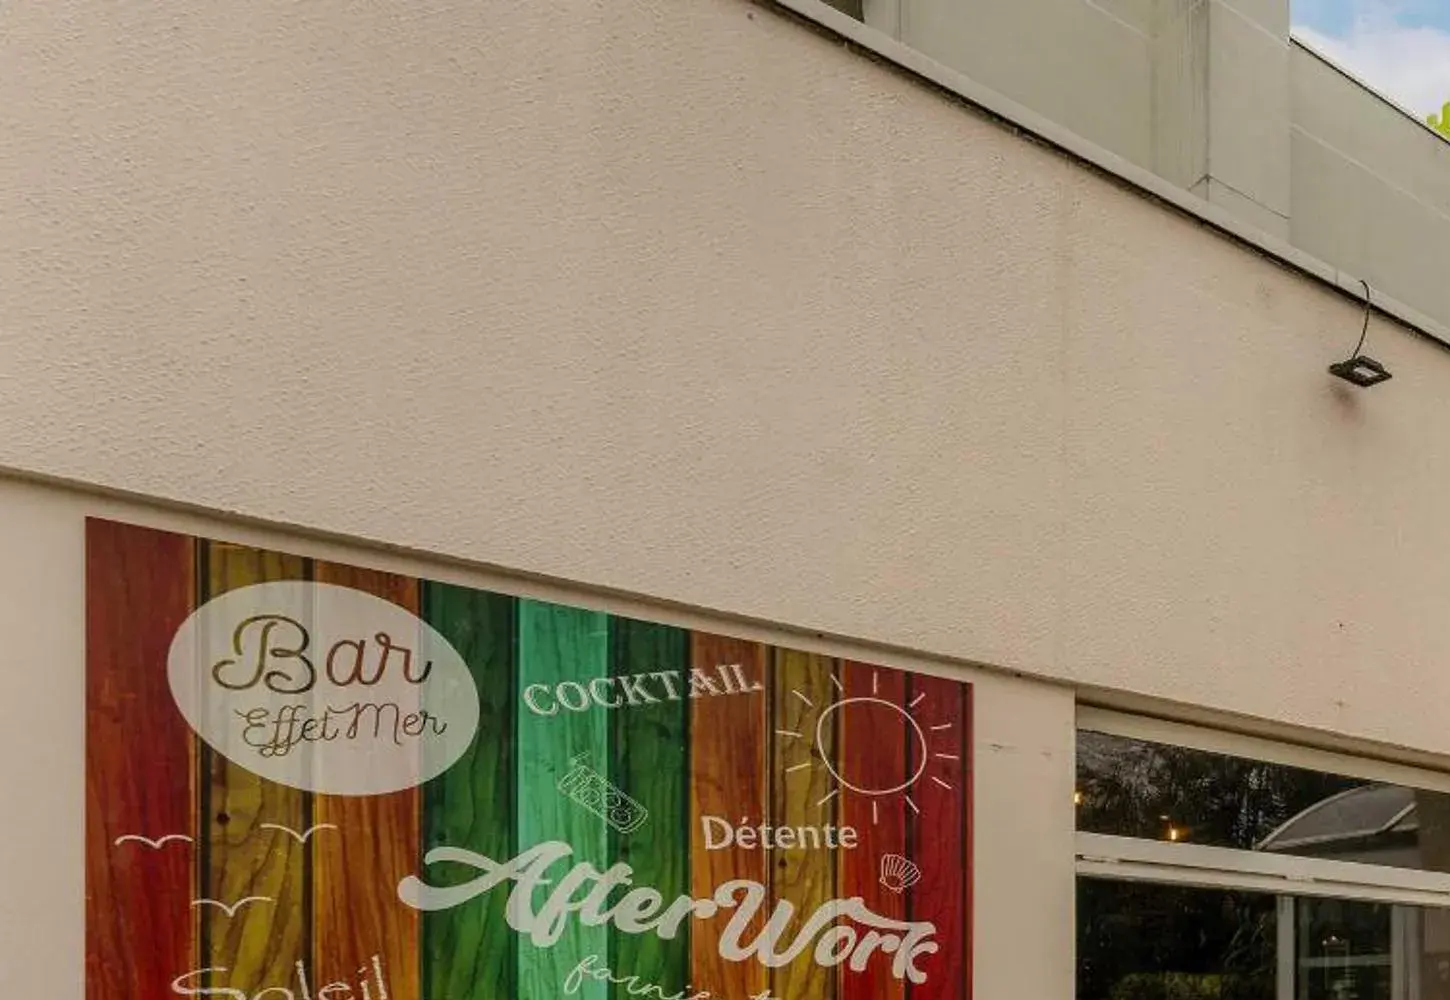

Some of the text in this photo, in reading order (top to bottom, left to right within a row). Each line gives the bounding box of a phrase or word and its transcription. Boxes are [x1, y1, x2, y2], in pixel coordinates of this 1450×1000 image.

[212, 614, 432, 695] Bar
[522, 663, 764, 717] COCKTAIL
[327, 702, 447, 746] Mer
[701, 815, 859, 851] Détente
